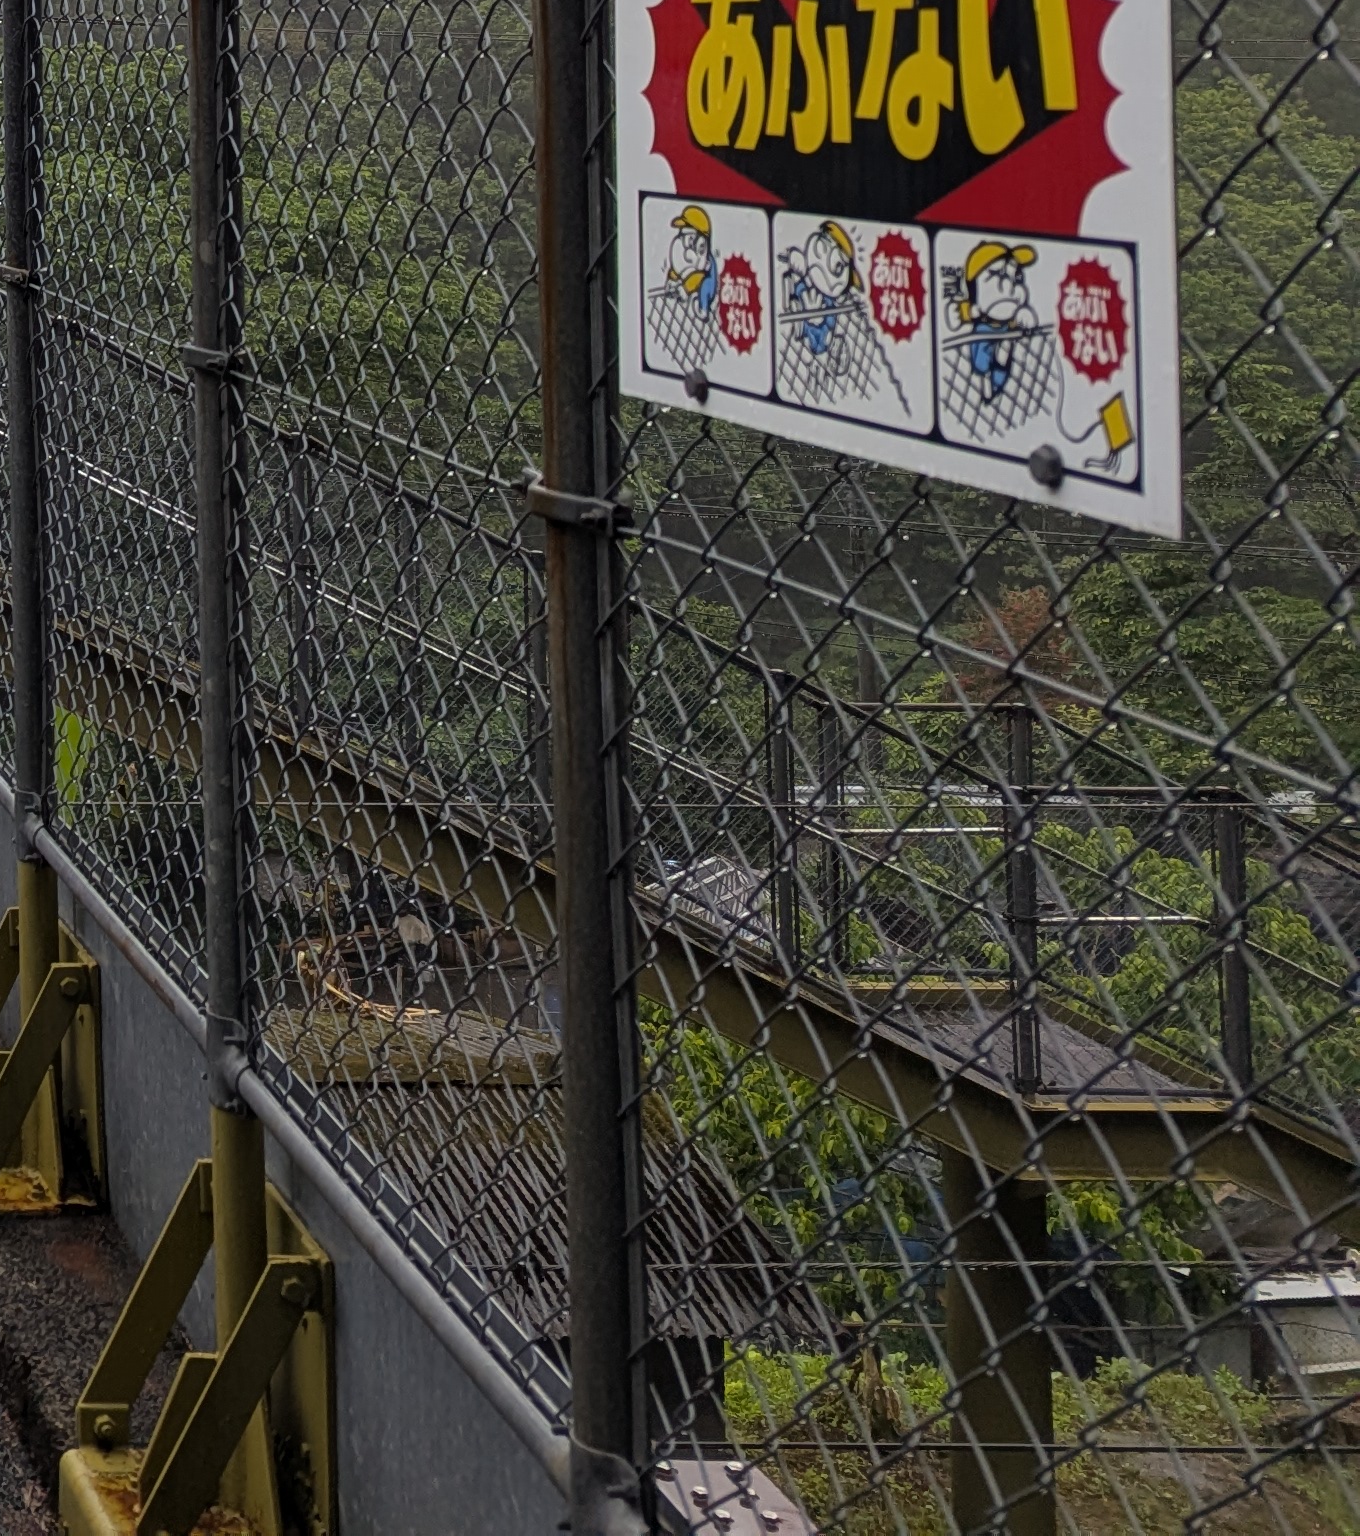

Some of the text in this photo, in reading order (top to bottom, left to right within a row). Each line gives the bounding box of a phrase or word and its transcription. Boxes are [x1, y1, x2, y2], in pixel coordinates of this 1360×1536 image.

[873, 251, 912, 289] あぶ
[880, 289, 918, 327] ない
[1062, 280, 1111, 323] あぶ
[1071, 322, 1118, 366] ない
